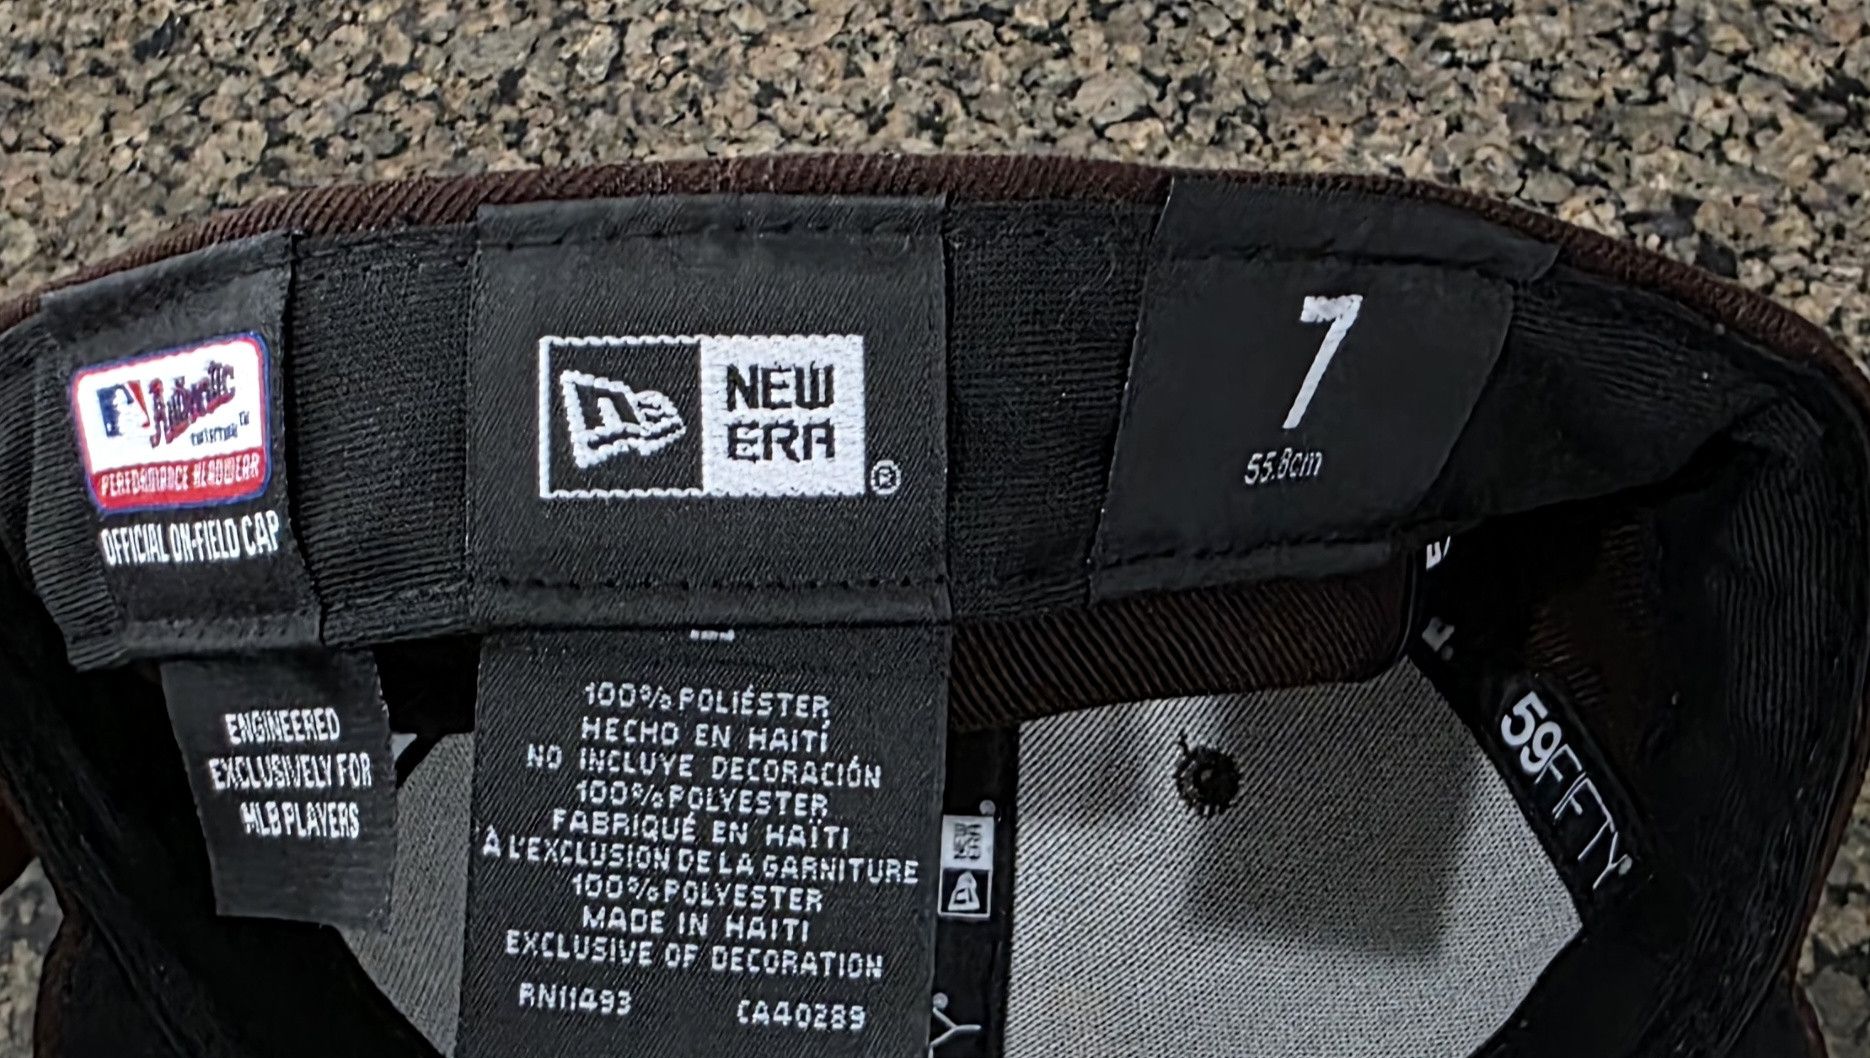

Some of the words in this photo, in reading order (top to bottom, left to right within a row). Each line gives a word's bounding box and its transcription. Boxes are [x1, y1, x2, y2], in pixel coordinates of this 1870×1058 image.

[1282, 294, 1363, 428] 7
[726, 363, 835, 412] NEW
[727, 419, 836, 463] ERA
[1244, 447, 1323, 486] 55.8cm
[100, 523, 170, 567] OFFICIAL
[169, 518, 241, 562] ON-FIELD
[240, 510, 280, 556] CAP
[584, 681, 672, 711] 100%
[678, 684, 831, 719] POLIÉSTER
[225, 707, 341, 745] ENGINEERED
[581, 716, 679, 745] HECHO
[695, 724, 731, 748] EN
[748, 719, 831, 753] HAITÍ
[208, 753, 332, 790] EXCLUSIVELY
[336, 752, 372, 787] FOR
[526, 743, 563, 770] NO
[579, 747, 695, 778] INCLUYE
[711, 755, 882, 789] DECORACIÓN
[575, 780, 664, 809] 100%
[668, 785, 829, 817] POLYESTER
[1499, 690, 1626, 892] 59FIFTY
[239, 801, 283, 836] MLB
[281, 801, 360, 839] PLAYERS
[552, 809, 697, 843] FABRIQUÉ
[712, 820, 749, 845] EN
[765, 818, 849, 850] HAÏTI
[508, 834, 670, 870] L'EXCLUSION
[677, 847, 711, 874] DE
[719, 850, 754, 877] LA
[762, 854, 919, 884] GARNITURE
[571, 873, 659, 902] 100%
[664, 878, 824, 913] POLYESTER
[582, 905, 665, 935] MADE
[678, 913, 709, 937] IN
[725, 918, 810, 943] HAITI
[505, 930, 654, 967] EXCLUSIVE
[664, 944, 699, 969] OF
[710, 945, 884, 980] DECORATION
[736, 1000, 866, 1031] CA40289
